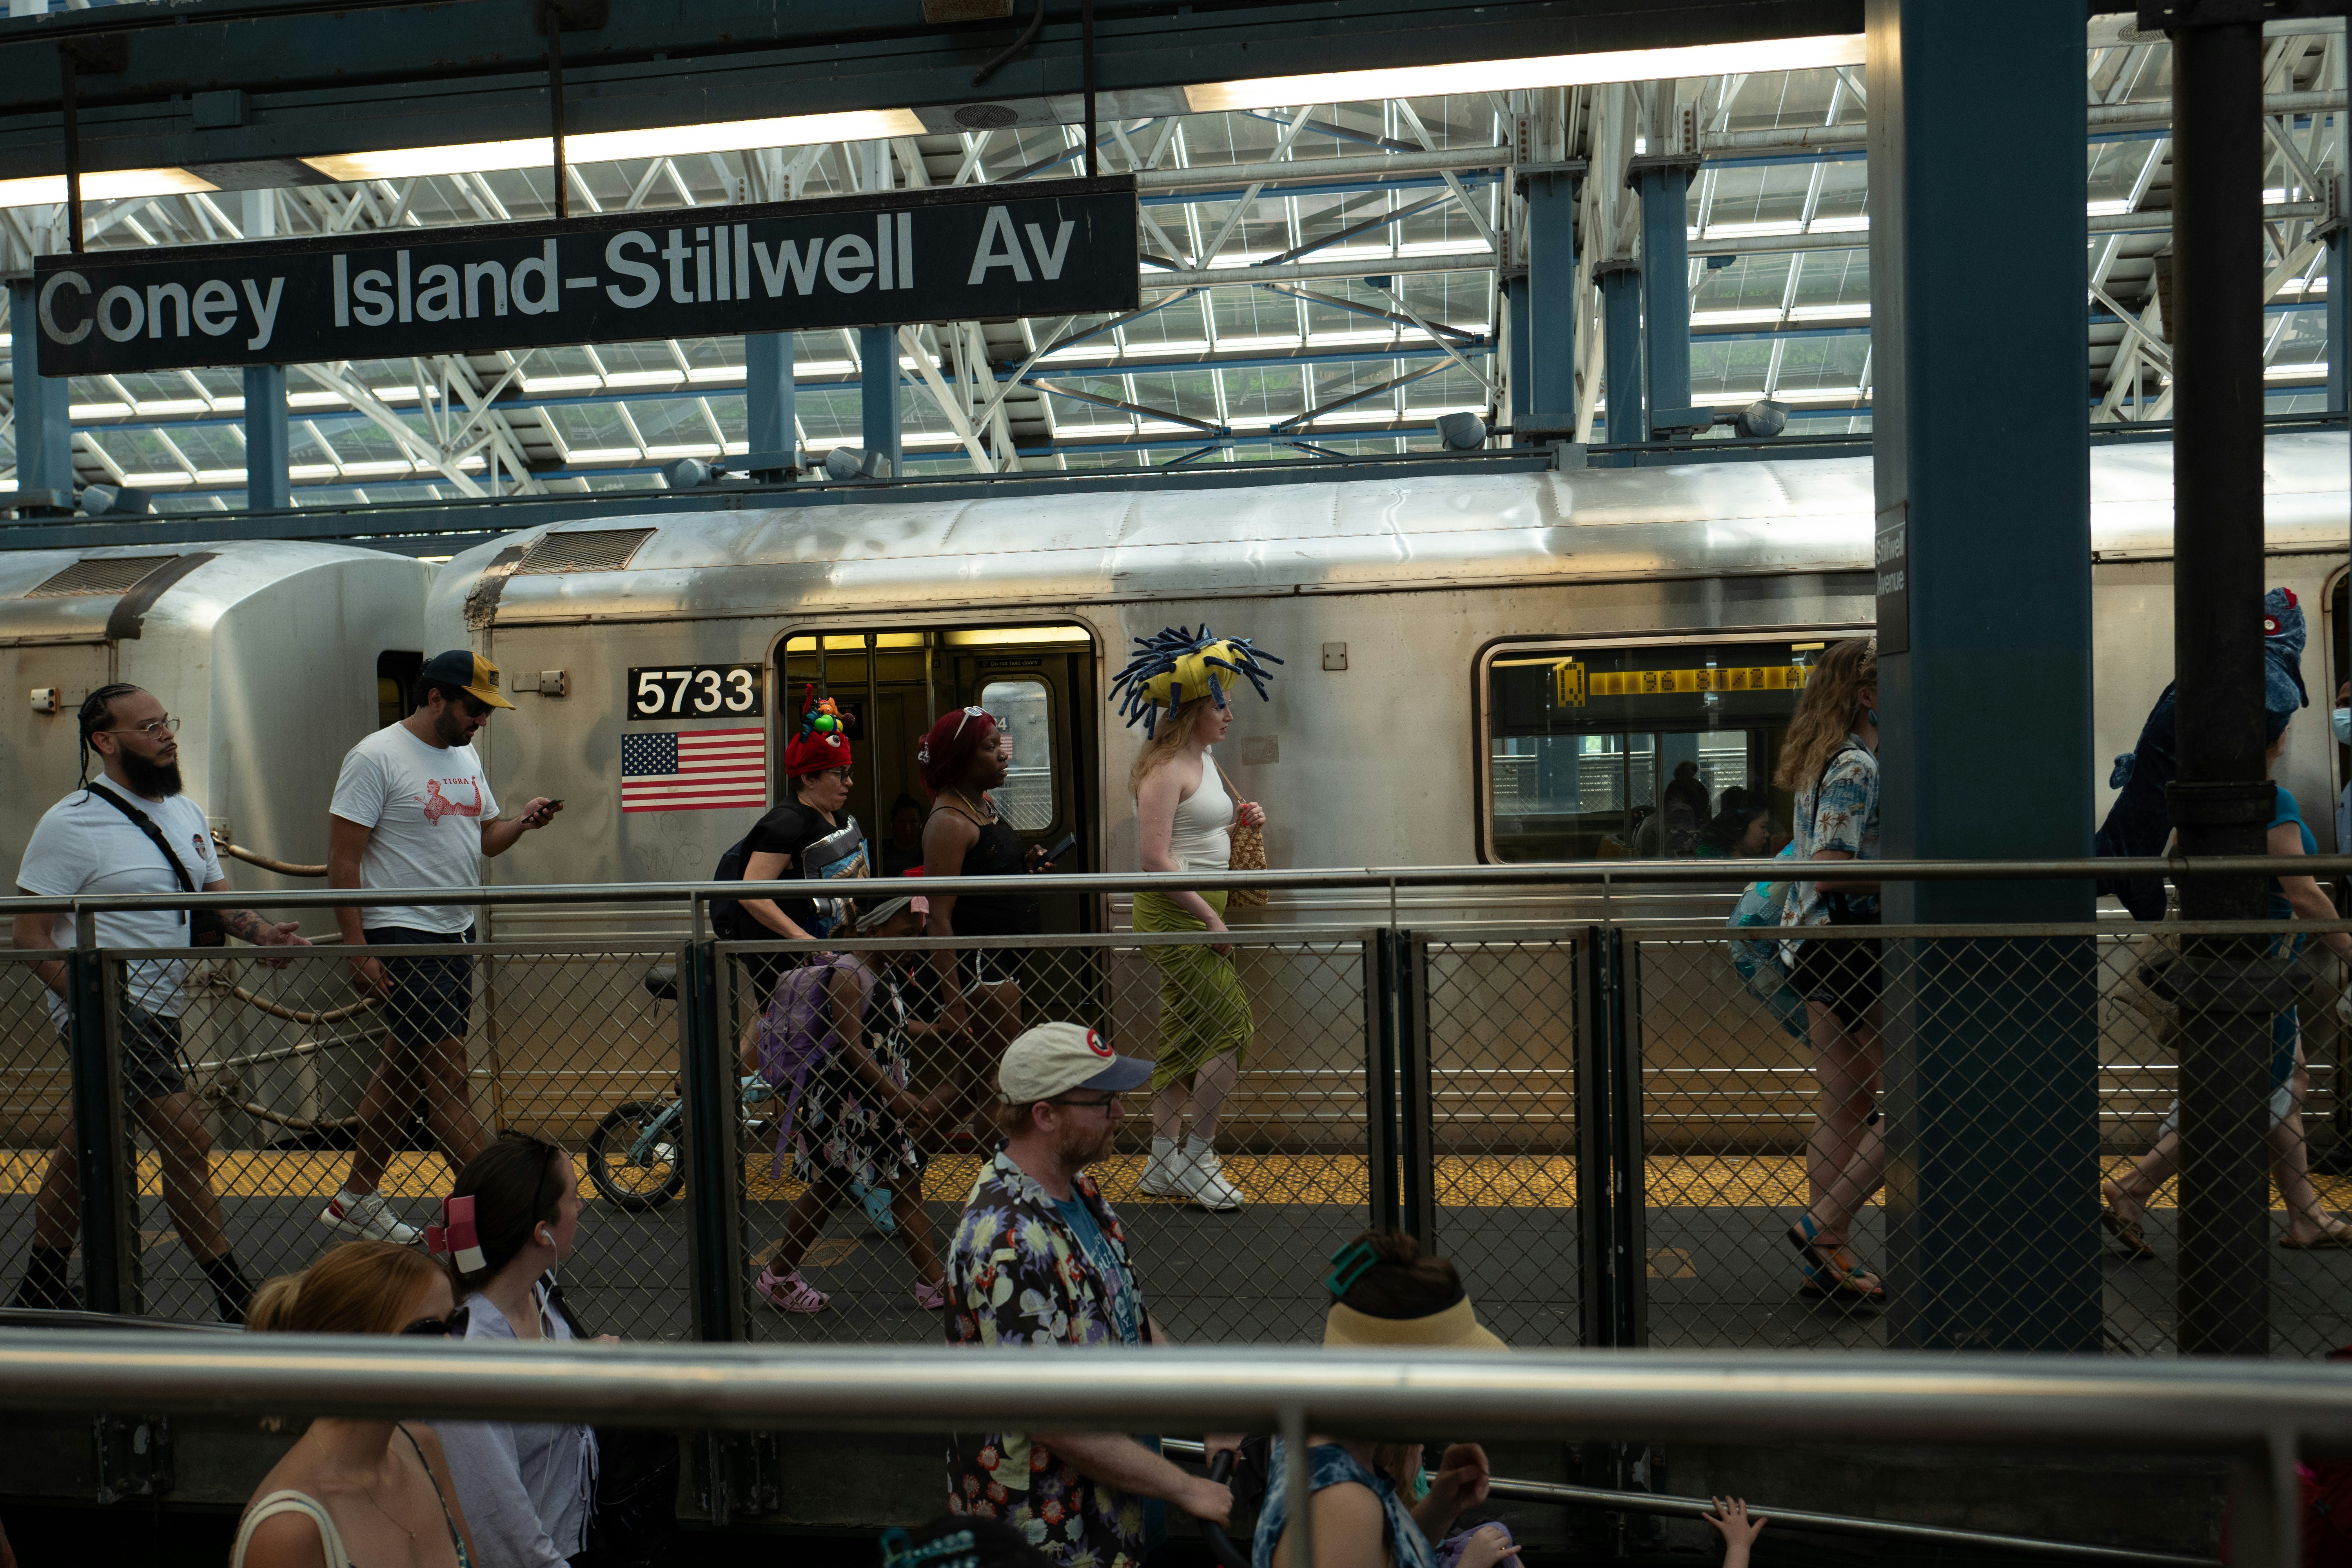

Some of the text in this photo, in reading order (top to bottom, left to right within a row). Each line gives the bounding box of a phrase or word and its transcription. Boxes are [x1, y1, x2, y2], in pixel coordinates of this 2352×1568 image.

[39, 206, 1075, 350] Coney Island-Stillwell Av
[1876, 531, 1904, 564] Stillwell
[1877, 570, 1904, 596] Avenue
[637, 670, 753, 713] 5733
[1561, 663, 1582, 706] Q
[1644, 668, 1807, 691] 96 ST/2 A
